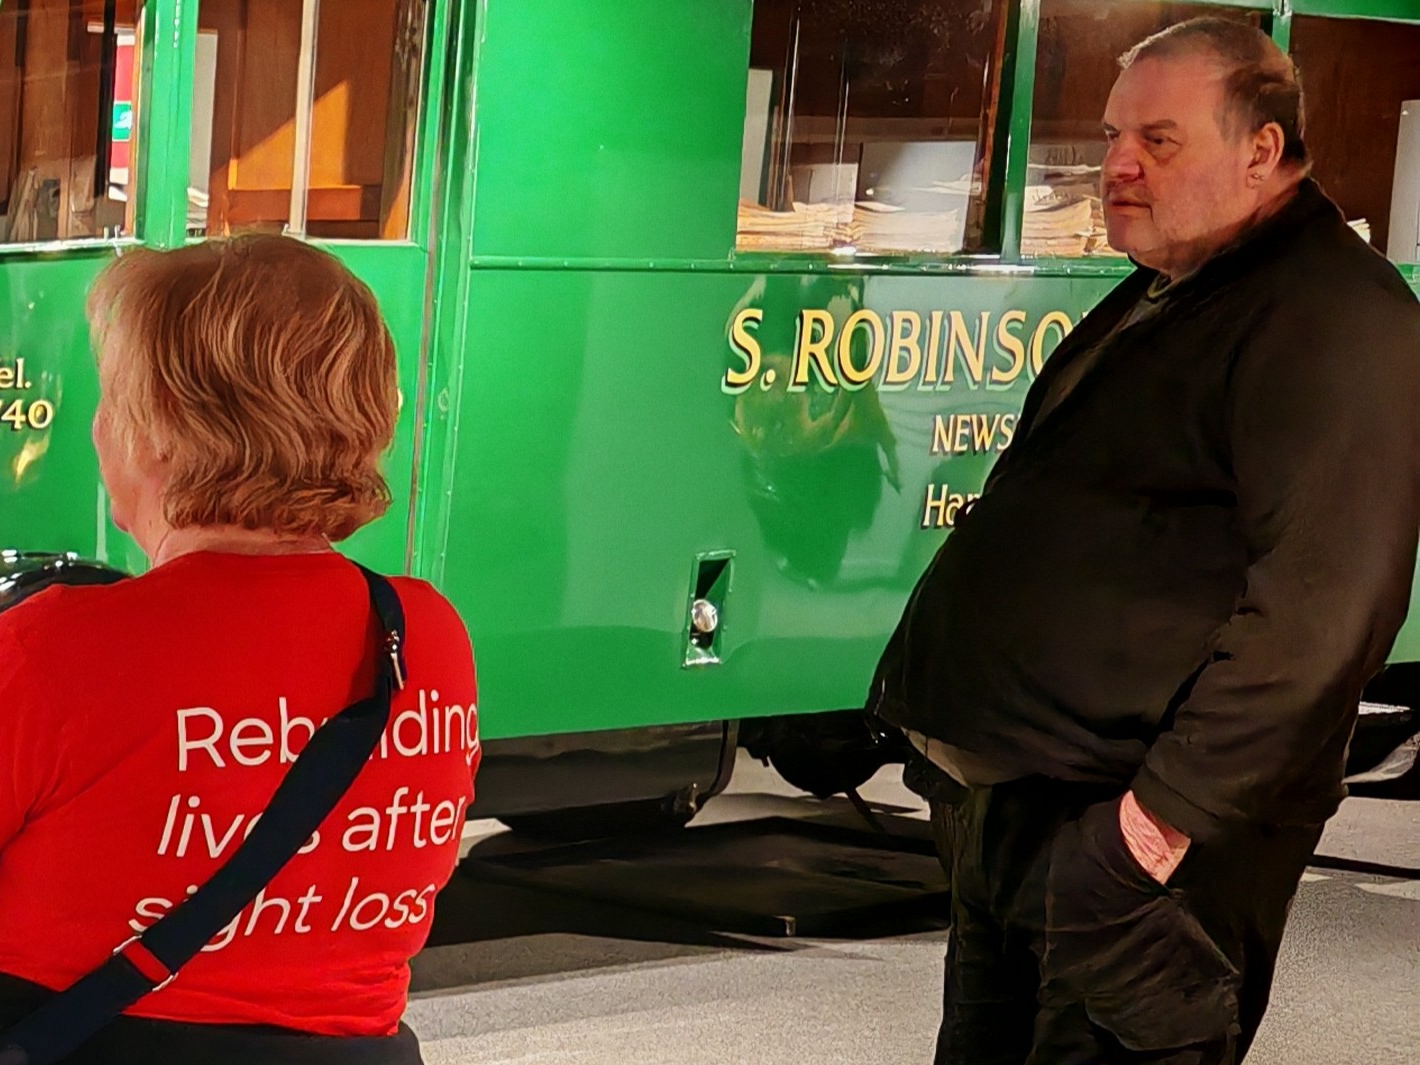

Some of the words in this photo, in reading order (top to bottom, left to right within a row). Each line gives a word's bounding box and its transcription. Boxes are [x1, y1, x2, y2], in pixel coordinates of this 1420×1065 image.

[723, 308, 776, 388] S.
[789, 308, 1088, 390] ROBINSO
[931, 413, 1022, 453] NEWS
[176, 688, 480, 771] Rebding
[157, 793, 322, 858] liv
[342, 786, 467, 853] after
[128, 884, 323, 953] sht
[331, 876, 437, 934] loss
